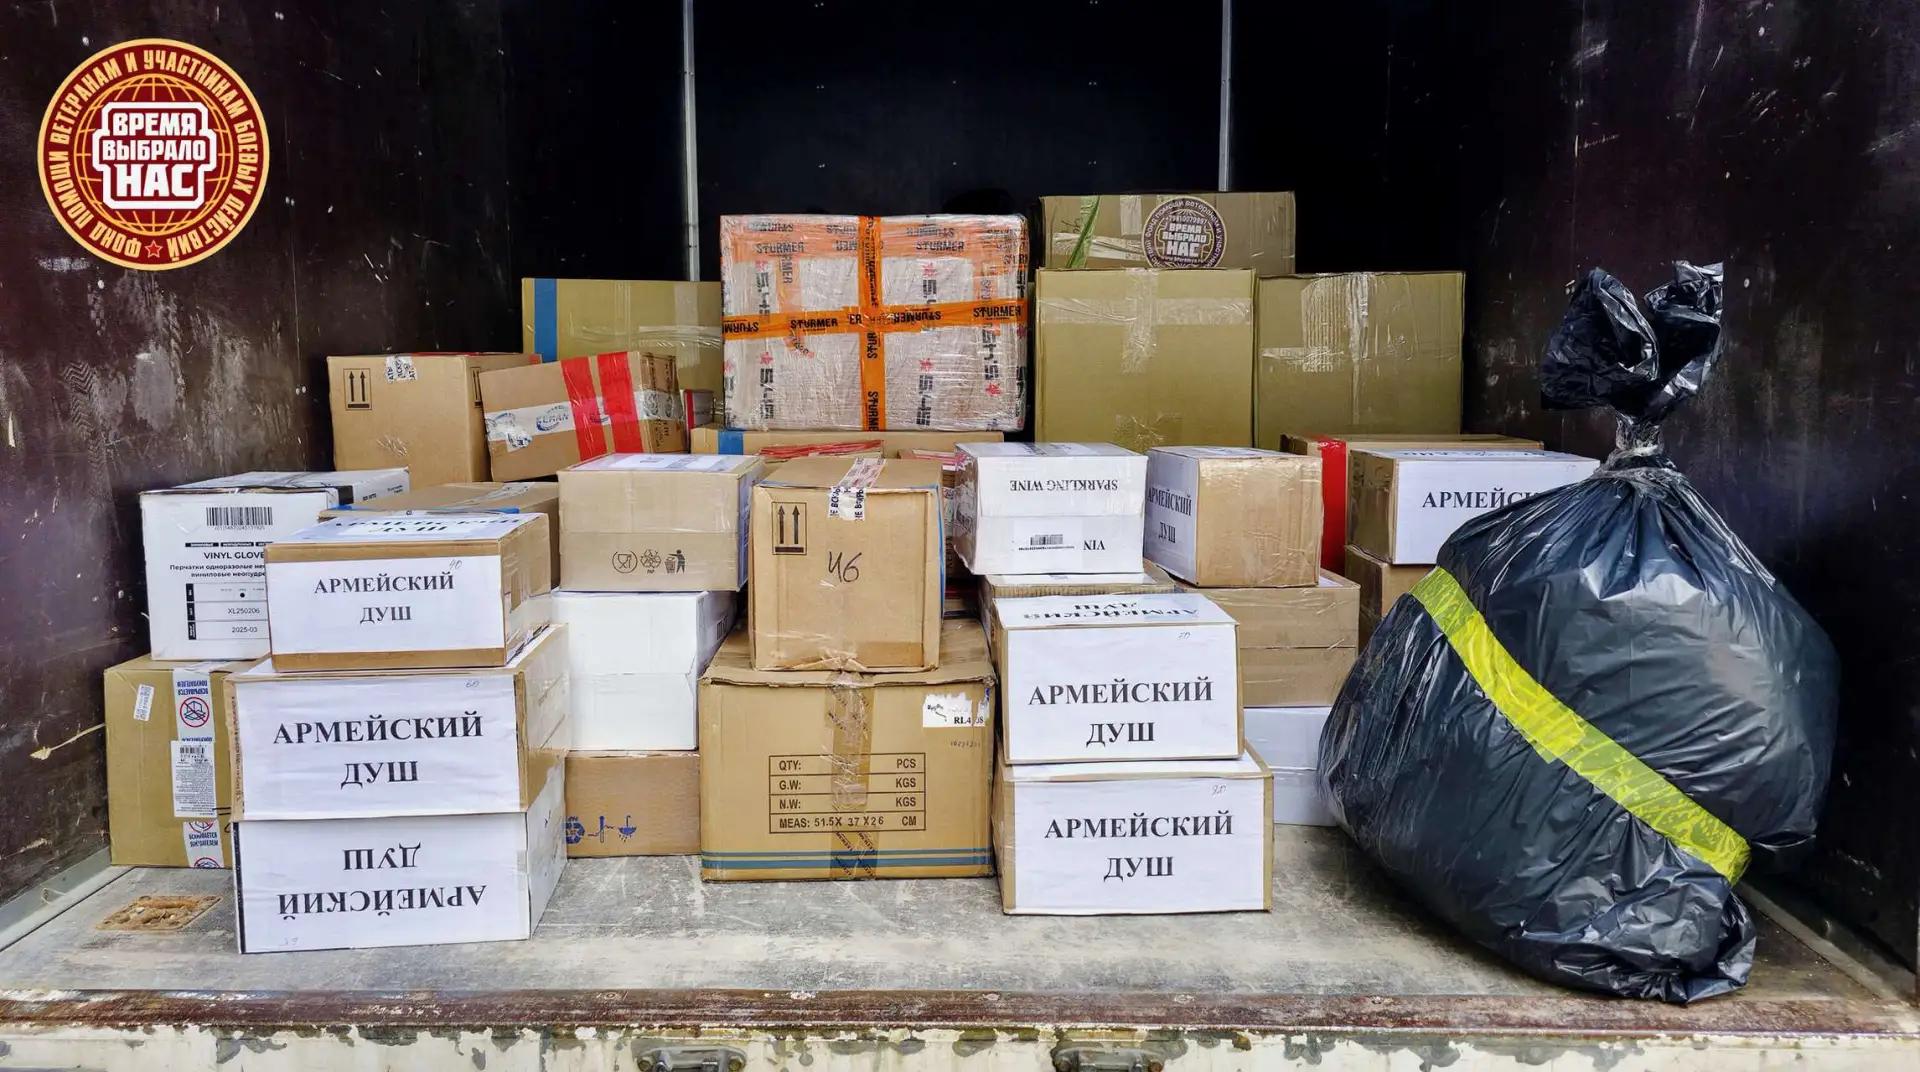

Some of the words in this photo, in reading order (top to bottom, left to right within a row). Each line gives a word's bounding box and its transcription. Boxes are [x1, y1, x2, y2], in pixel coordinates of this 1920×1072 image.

[1168, 222, 1202, 234] ВРЕМЯ
[1162, 231, 1207, 243] ВЫБРАЛО
[756, 241, 805, 254] STURMER
[916, 240, 965, 252] STURMER
[1166, 241, 1200, 258] НАС
[893, 311, 942, 323] STURMER
[973, 305, 1022, 318] STURMER
[790, 318, 838, 329] STURMER
[1010, 478, 1045, 491] WINE
[1047, 478, 1118, 491] SPARKLING
[1148, 486, 1192, 516] АРМЕЙСКИЙ
[1421, 487, 1534, 508] АРМЕЙС
[1158, 521, 1176, 543] ДУШ
[1083, 539, 1106, 551] VIN
[203, 551, 232, 560] VINYL
[314, 571, 455, 595] АРМЕЙСКИЙ
[227, 607, 260, 615] XL250206
[360, 605, 413, 624] ДУШ
[1028, 676, 1214, 706] АРМЕЙСКИЙ
[272, 711, 484, 745] АРМЕЙСКИЙ
[1086, 722, 1155, 748] ДУШ
[779, 759, 802, 771] QTY:
[896, 758, 917, 769] PCS
[340, 760, 419, 790] ДУШ
[779, 779, 801, 790] G.W:
[895, 777, 917, 788] KGS
[779, 798, 801, 810] N.W:
[895, 796, 917, 807] KGS
[779, 817, 811, 829] MEAS:
[901, 815, 917, 826] CM
[1044, 810, 1234, 839] АРМЕЙСКИЙ
[343, 843, 421, 871] ДУШ
[1103, 856, 1174, 882] ДУШ
[278, 885, 487, 921] АРМЕЙСКИЙ
